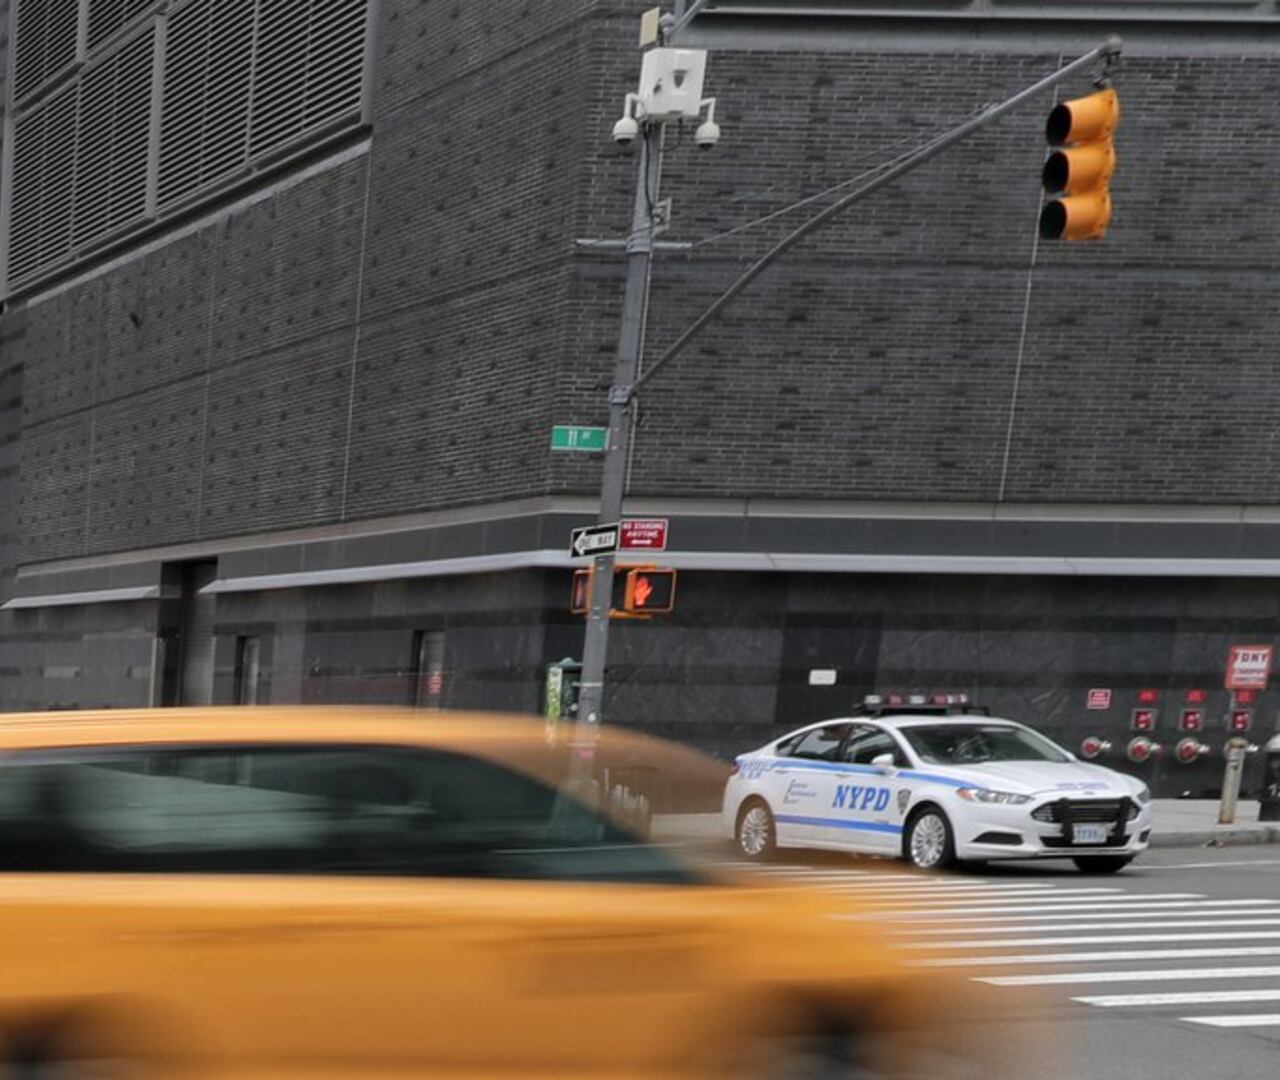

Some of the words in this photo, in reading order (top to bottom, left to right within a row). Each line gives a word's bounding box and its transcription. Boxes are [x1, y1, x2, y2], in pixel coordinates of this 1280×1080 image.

[568, 431, 578, 446] 11
[598, 534, 613, 545] WAY
[831, 784, 890, 811] NYPD
